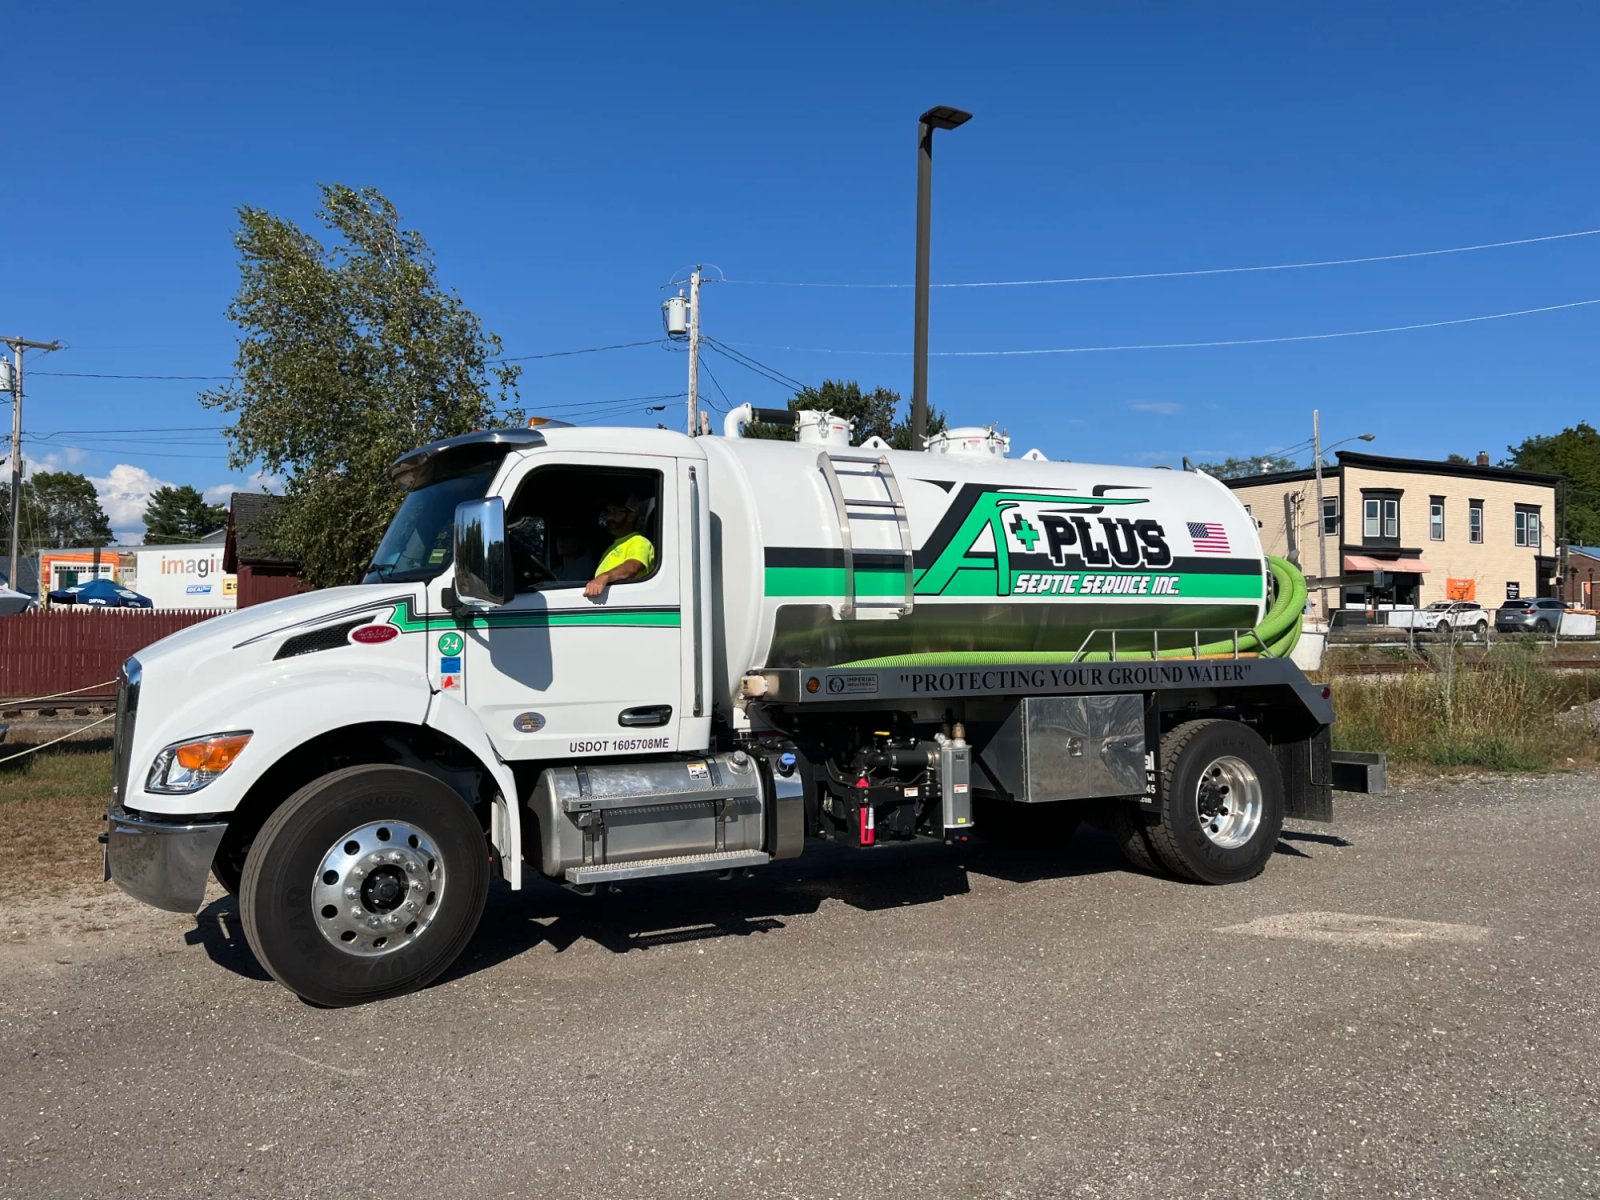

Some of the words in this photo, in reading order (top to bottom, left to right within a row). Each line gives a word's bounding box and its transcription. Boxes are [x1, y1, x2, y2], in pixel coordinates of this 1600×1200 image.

[1036, 513, 1172, 567] PLUS
[1014, 574, 1080, 594] SEPTIC
[1079, 575, 1153, 594] SERVICE
[1151, 576, 1180, 594] INC.
[441, 638, 459, 650] 24
[900, 669, 1045, 692] "PROTECTING
[1050, 667, 1103, 686] YOUR
[1108, 665, 1183, 685] GROUND
[1187, 664, 1251, 682] WATER"
[569, 740, 609, 753] USDOT
[612, 737, 669, 751] 1605708ME
